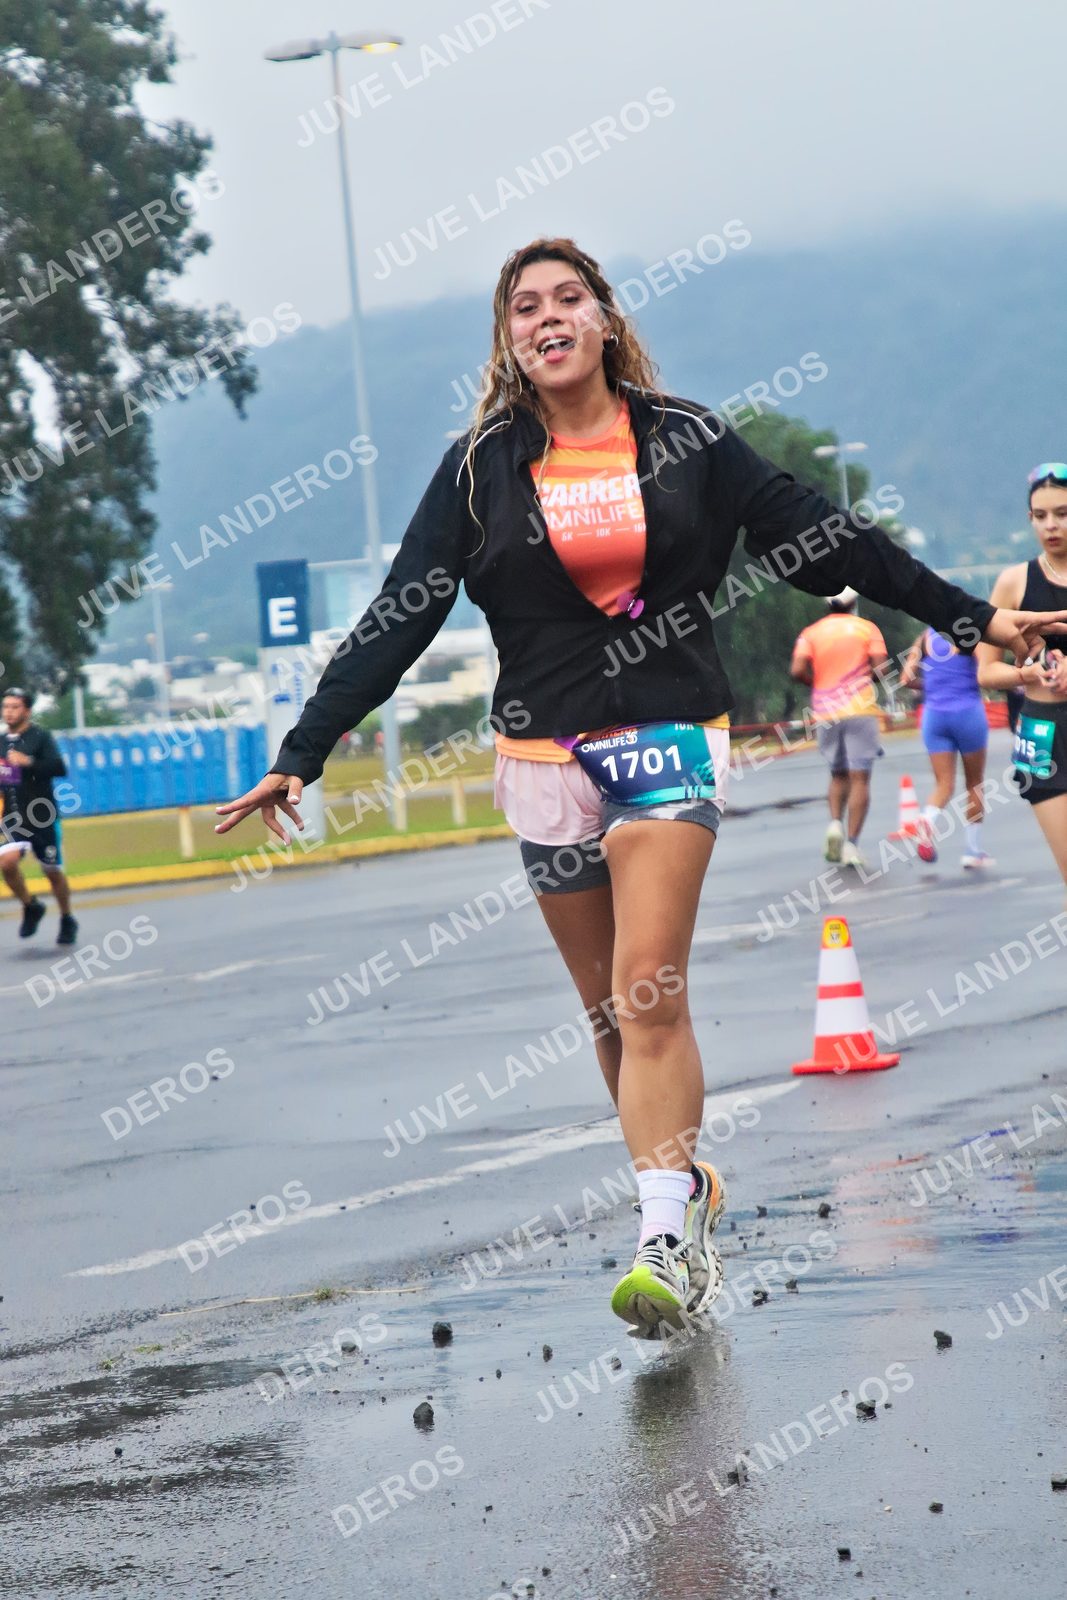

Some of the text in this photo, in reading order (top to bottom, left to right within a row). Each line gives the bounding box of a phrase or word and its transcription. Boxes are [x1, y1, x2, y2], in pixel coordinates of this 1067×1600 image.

[538, 473, 642, 508] CARRER
[544, 501, 643, 531] MNILIFE
[268, 596, 299, 638] E
[581, 736, 626, 753] OMNILIFE
[602, 745, 682, 782] 1701
